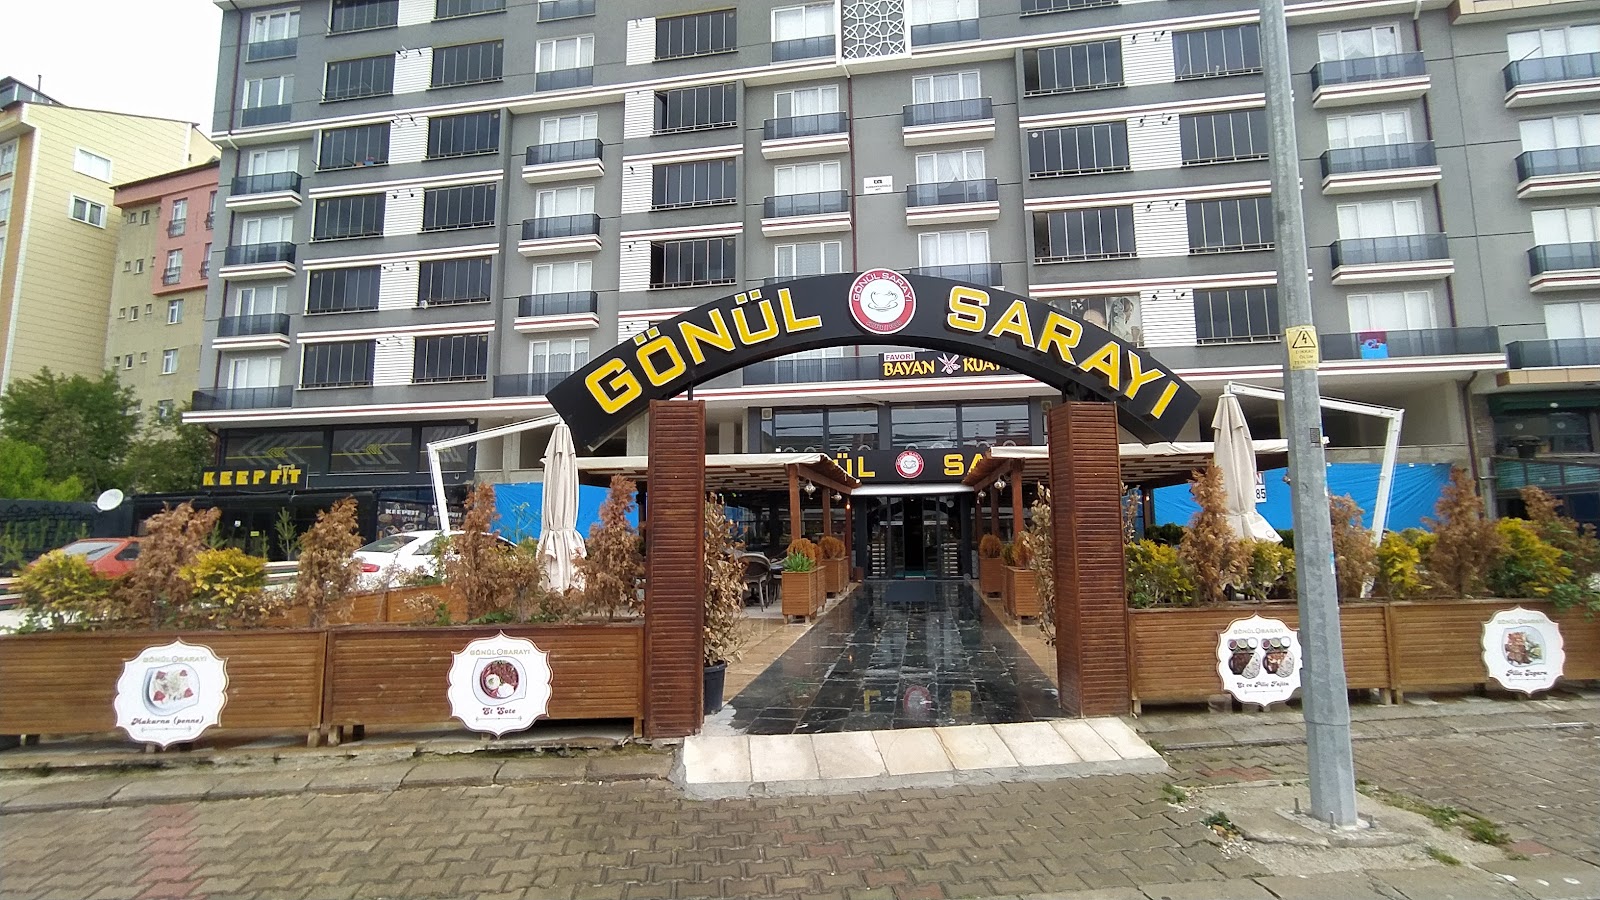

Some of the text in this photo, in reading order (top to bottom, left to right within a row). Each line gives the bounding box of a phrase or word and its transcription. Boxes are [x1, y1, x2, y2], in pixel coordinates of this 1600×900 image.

[853, 272, 912, 302] GÖNÜL SARAYI
[584, 285, 1180, 420] GÖNÜL SARAYI
[883, 360, 935, 377] BAYAN
